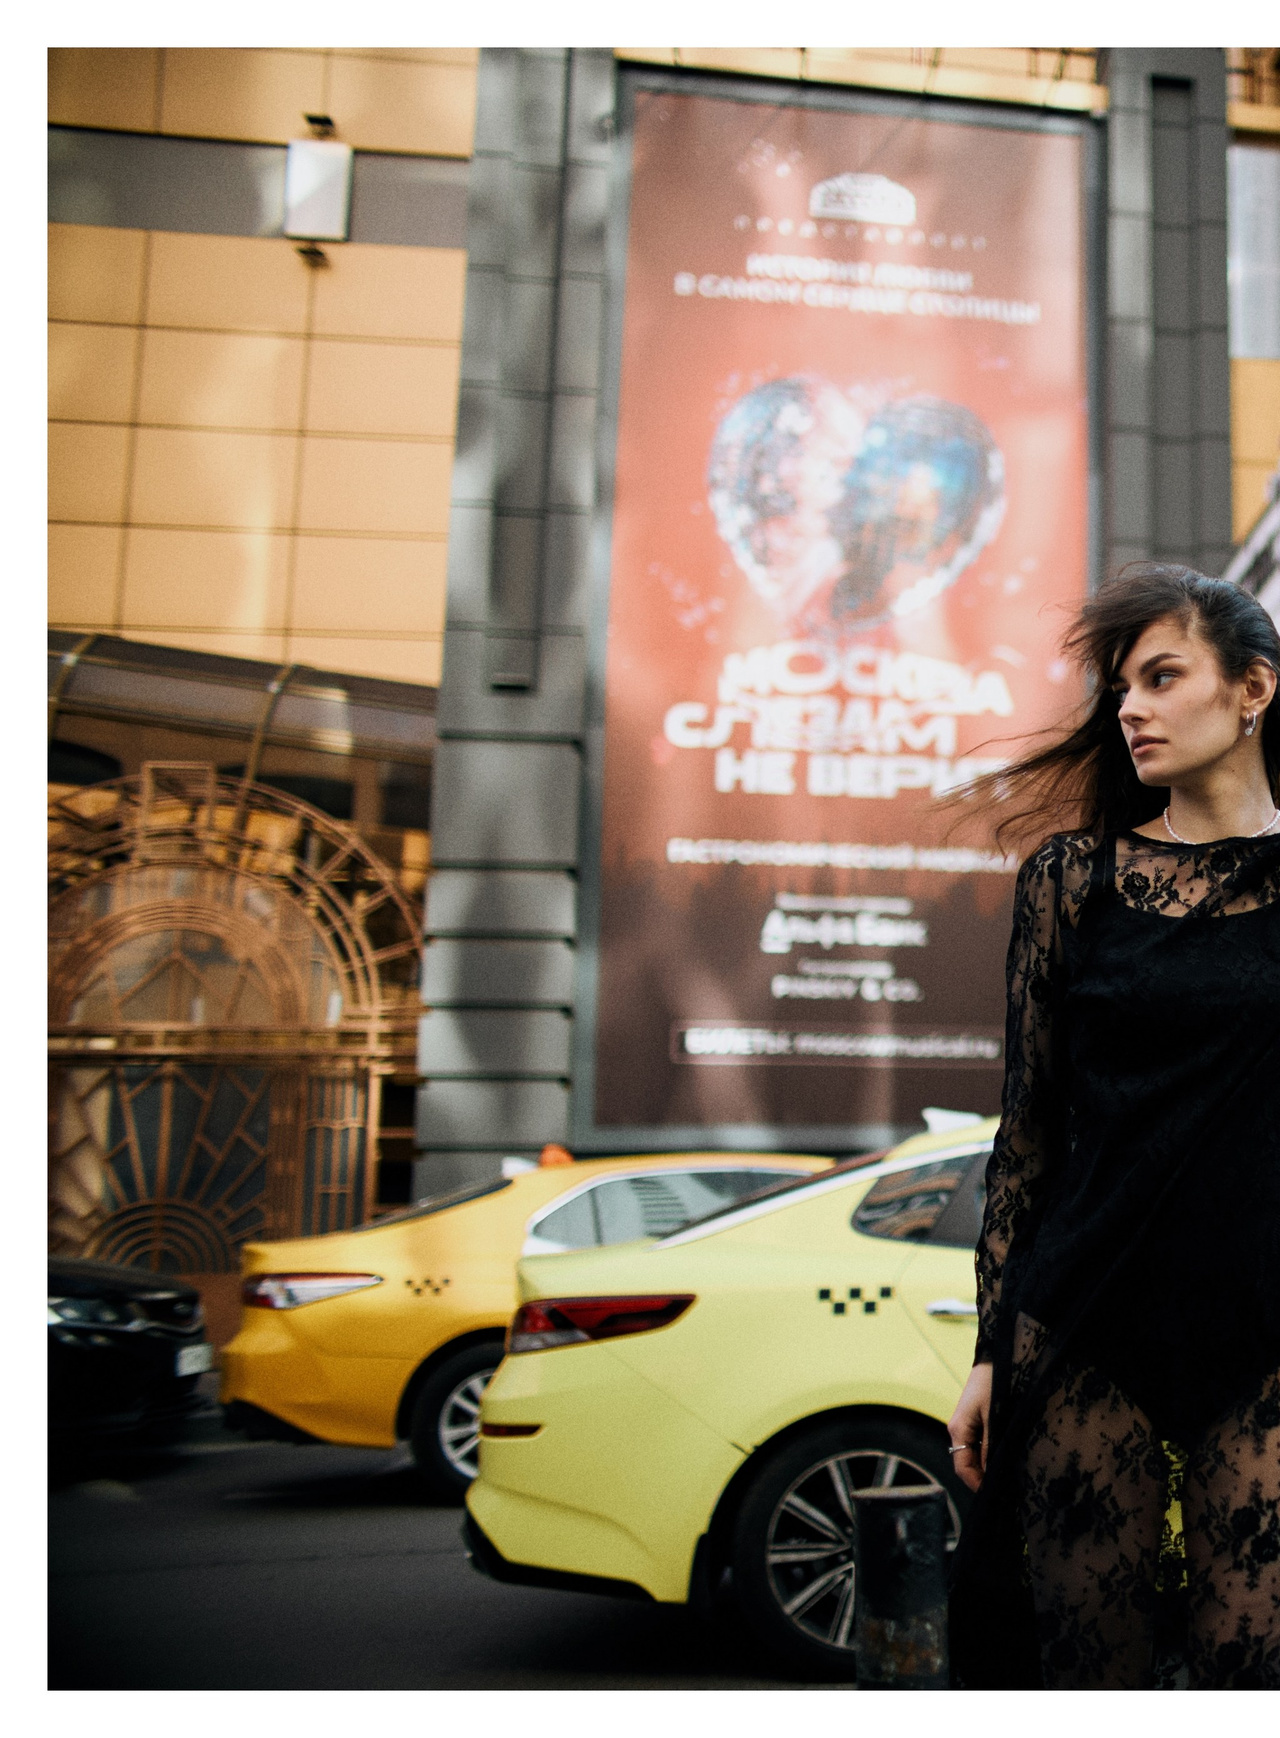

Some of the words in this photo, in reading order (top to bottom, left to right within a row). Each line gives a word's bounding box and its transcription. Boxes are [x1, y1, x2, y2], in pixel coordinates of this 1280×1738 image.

[718, 640, 1014, 718] МОСКВА
[663, 693, 957, 757] СЛЕЗАМ
[714, 748, 796, 796] НЕ
